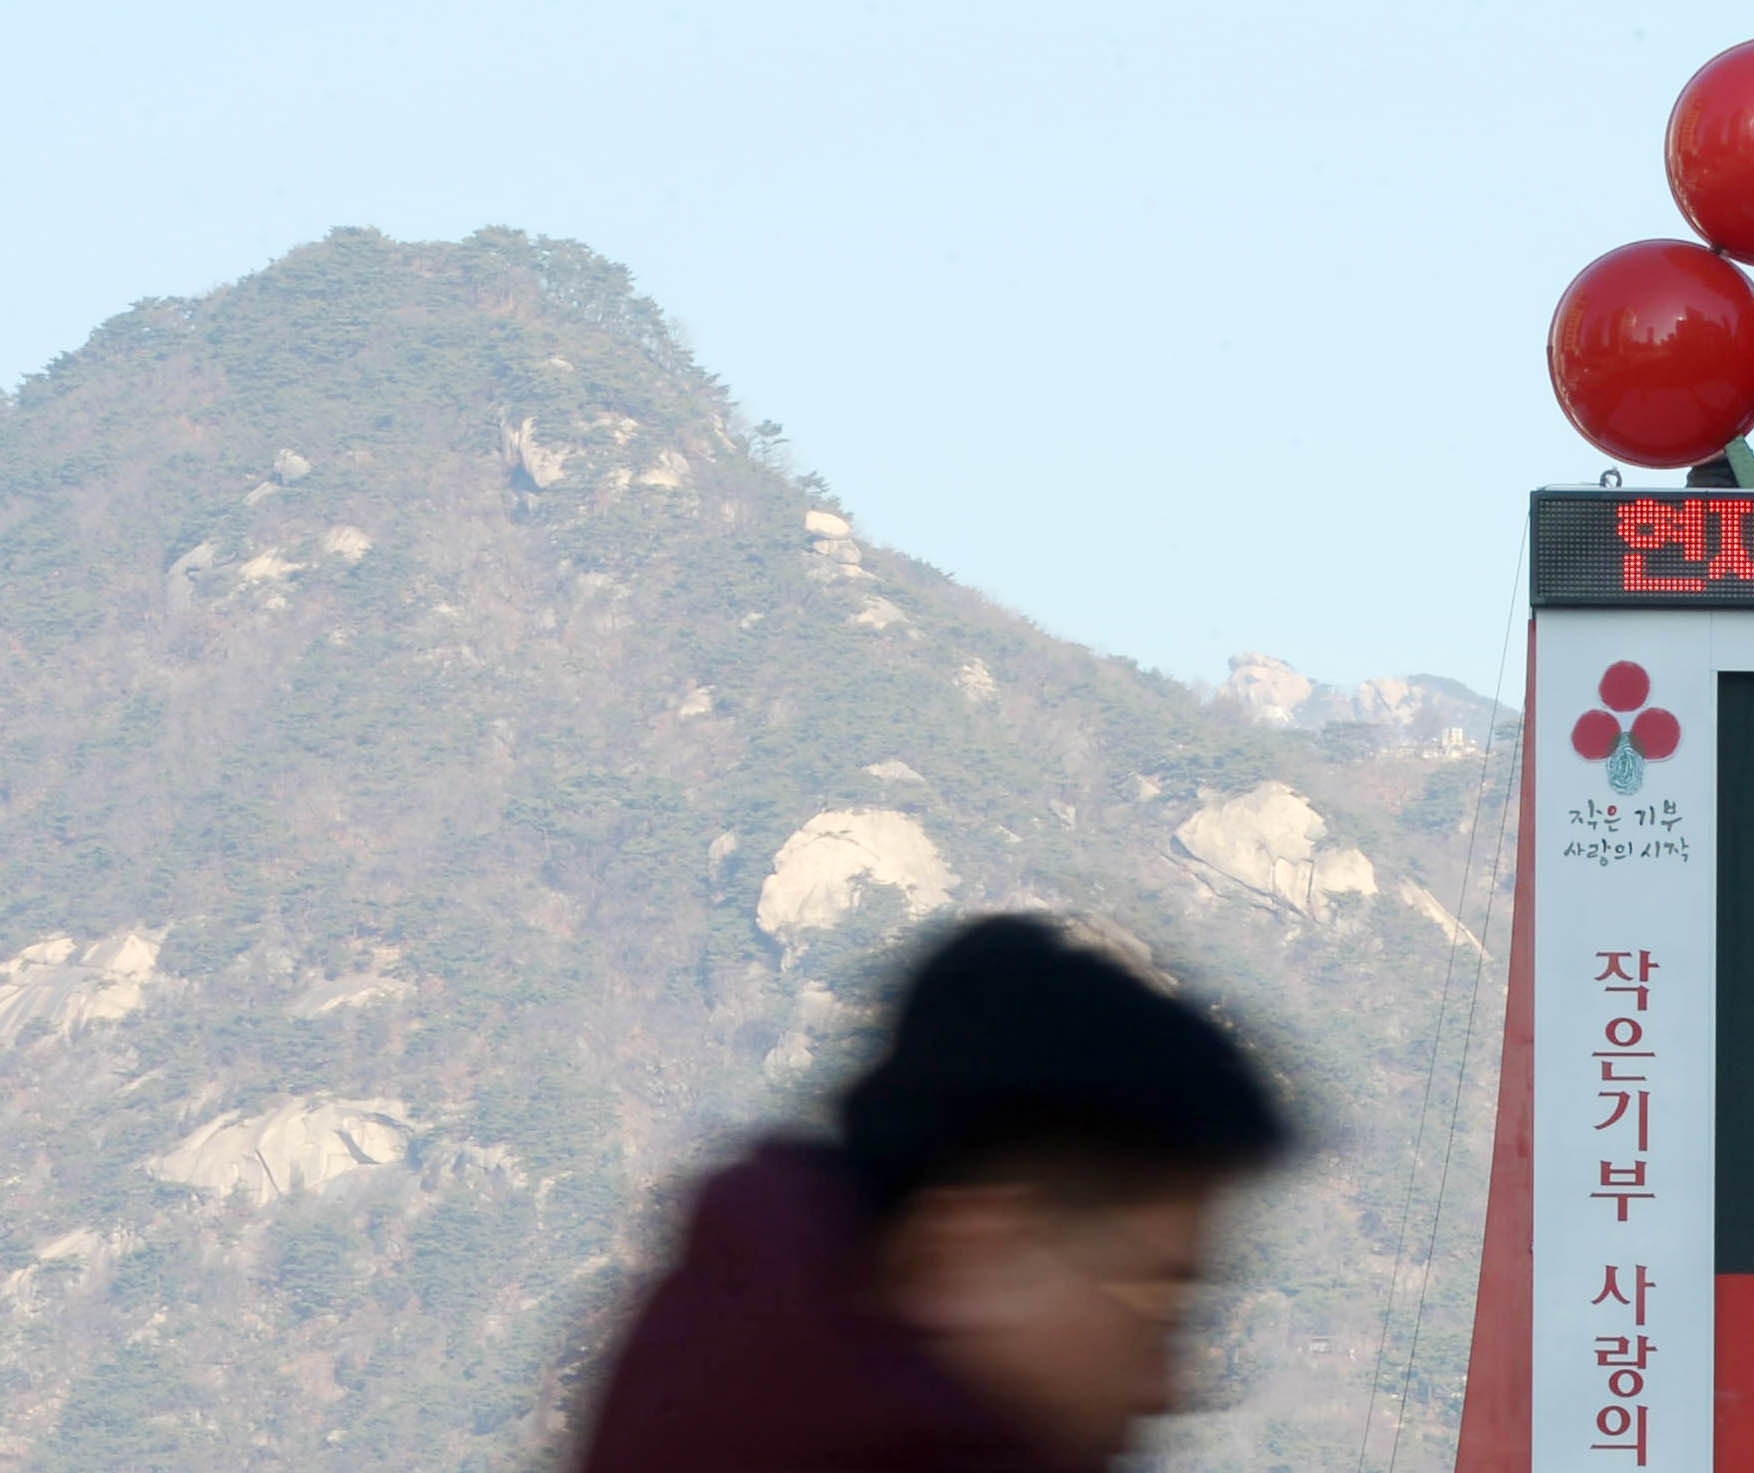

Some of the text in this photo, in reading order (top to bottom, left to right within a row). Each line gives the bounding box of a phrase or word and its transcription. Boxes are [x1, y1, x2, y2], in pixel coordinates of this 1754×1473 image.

[1568, 799, 1683, 832] 작은 기부
[1563, 836, 1690, 867] 사랑의 시작
[1590, 1264, 1659, 1467] 사랑의
